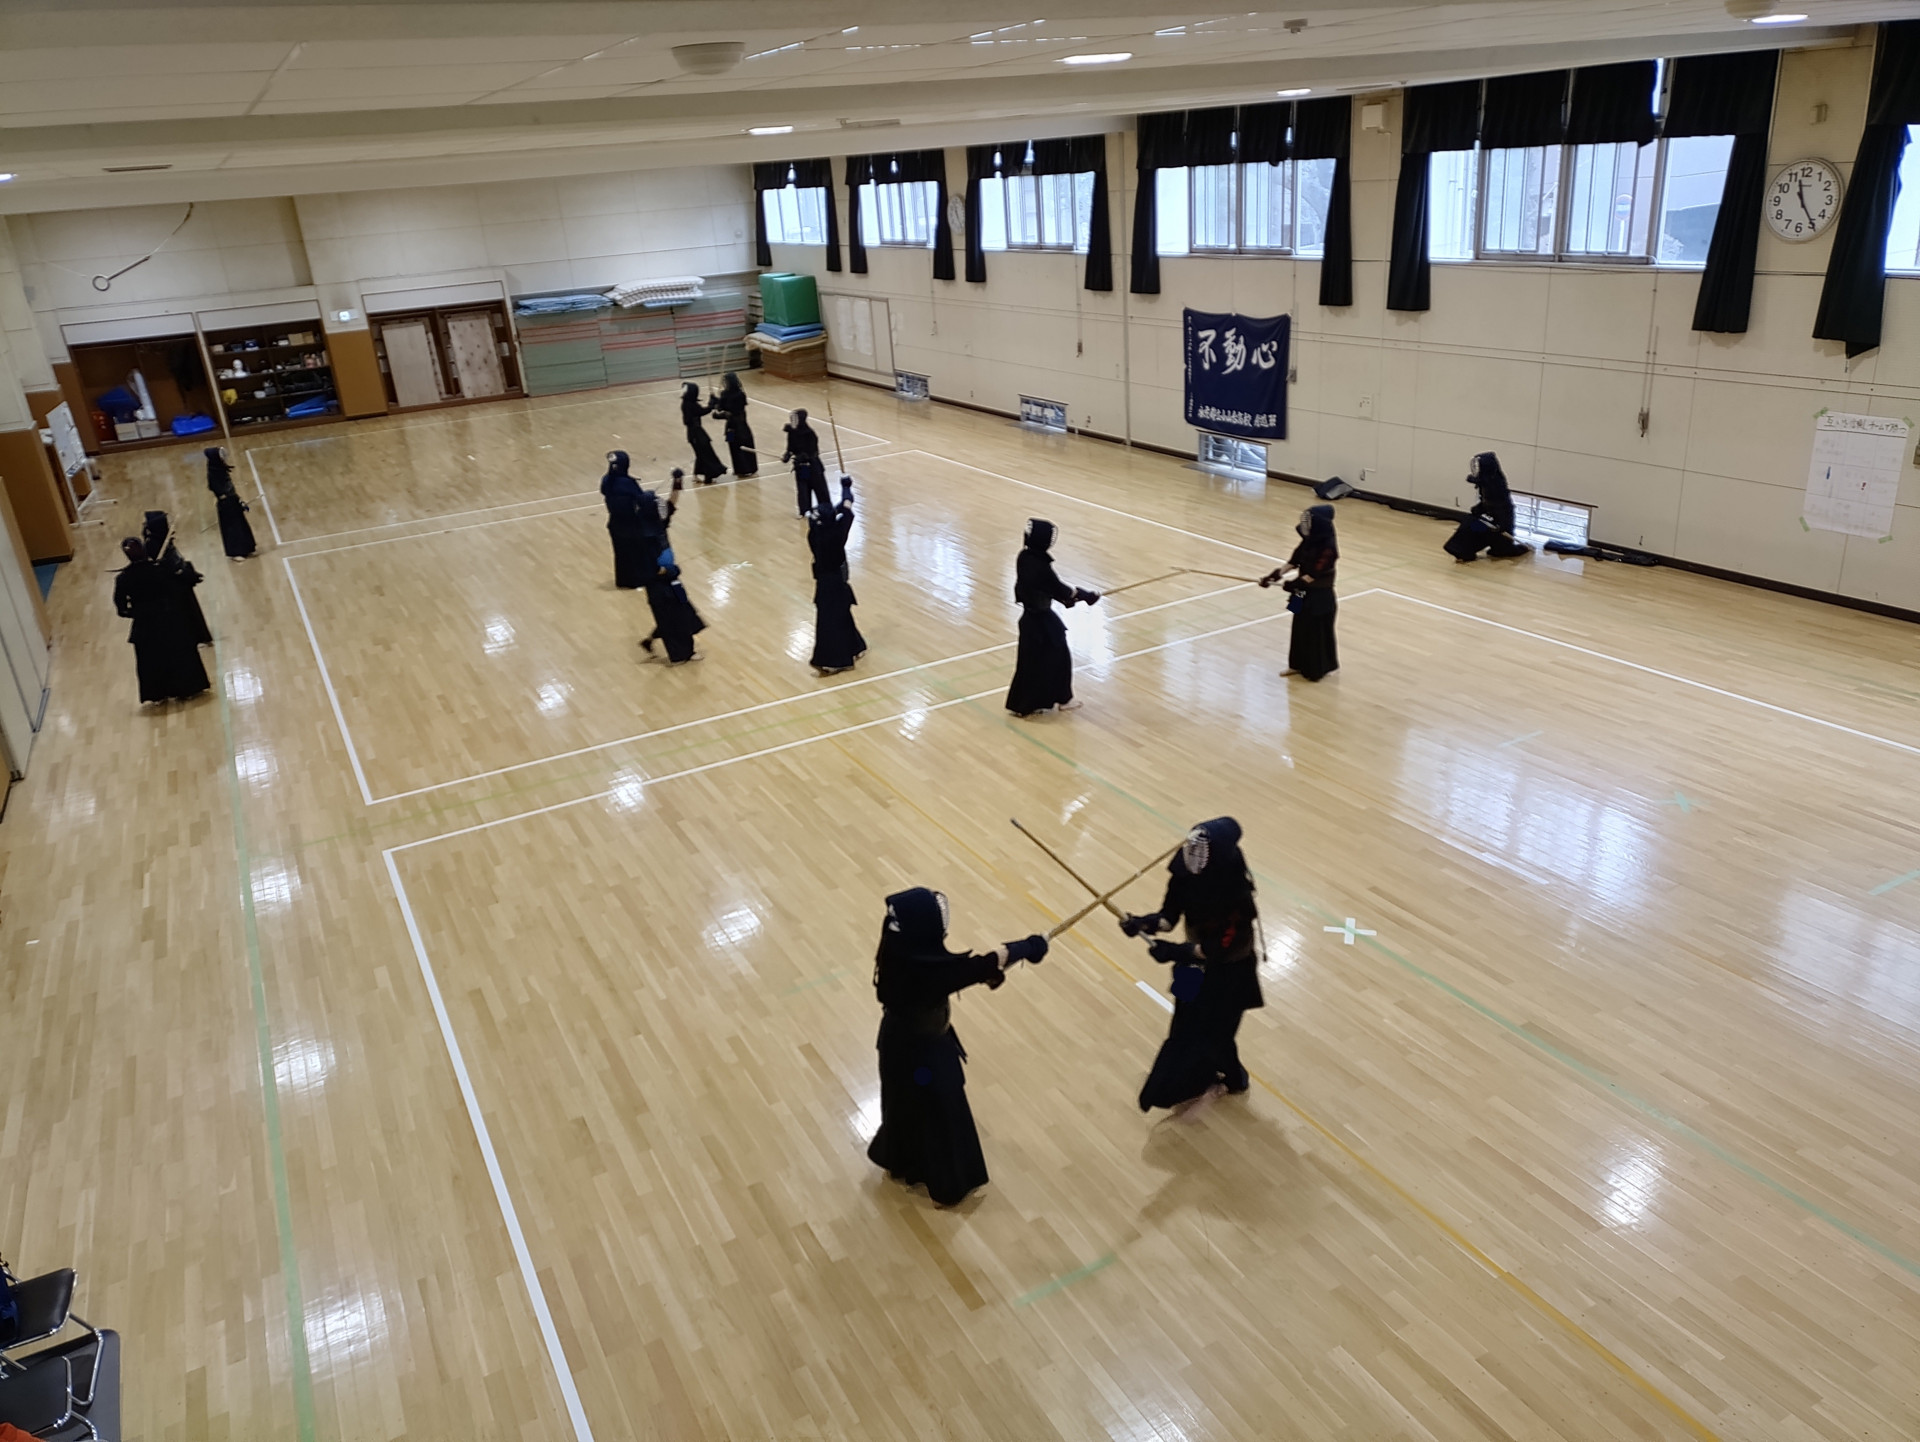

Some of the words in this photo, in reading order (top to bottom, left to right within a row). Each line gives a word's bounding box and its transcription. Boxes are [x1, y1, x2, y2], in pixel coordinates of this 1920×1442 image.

[1788, 172, 1798, 183] 11
[1800, 166, 1813, 178] 12
[1817, 172, 1822, 182] 1
[1778, 182, 1790, 194] 10
[1823, 180, 1832, 191] 2
[1773, 195, 1781, 206] 9
[1825, 195, 1833, 206] 3
[1775, 209, 1783, 220] 8
[1818, 209, 1826, 220] 4
[1784, 219, 1792, 230] 7
[1794, 222, 1803, 233] 6
[1808, 218, 1816, 229] 5
[1197, 327, 1278, 375] 不動心
